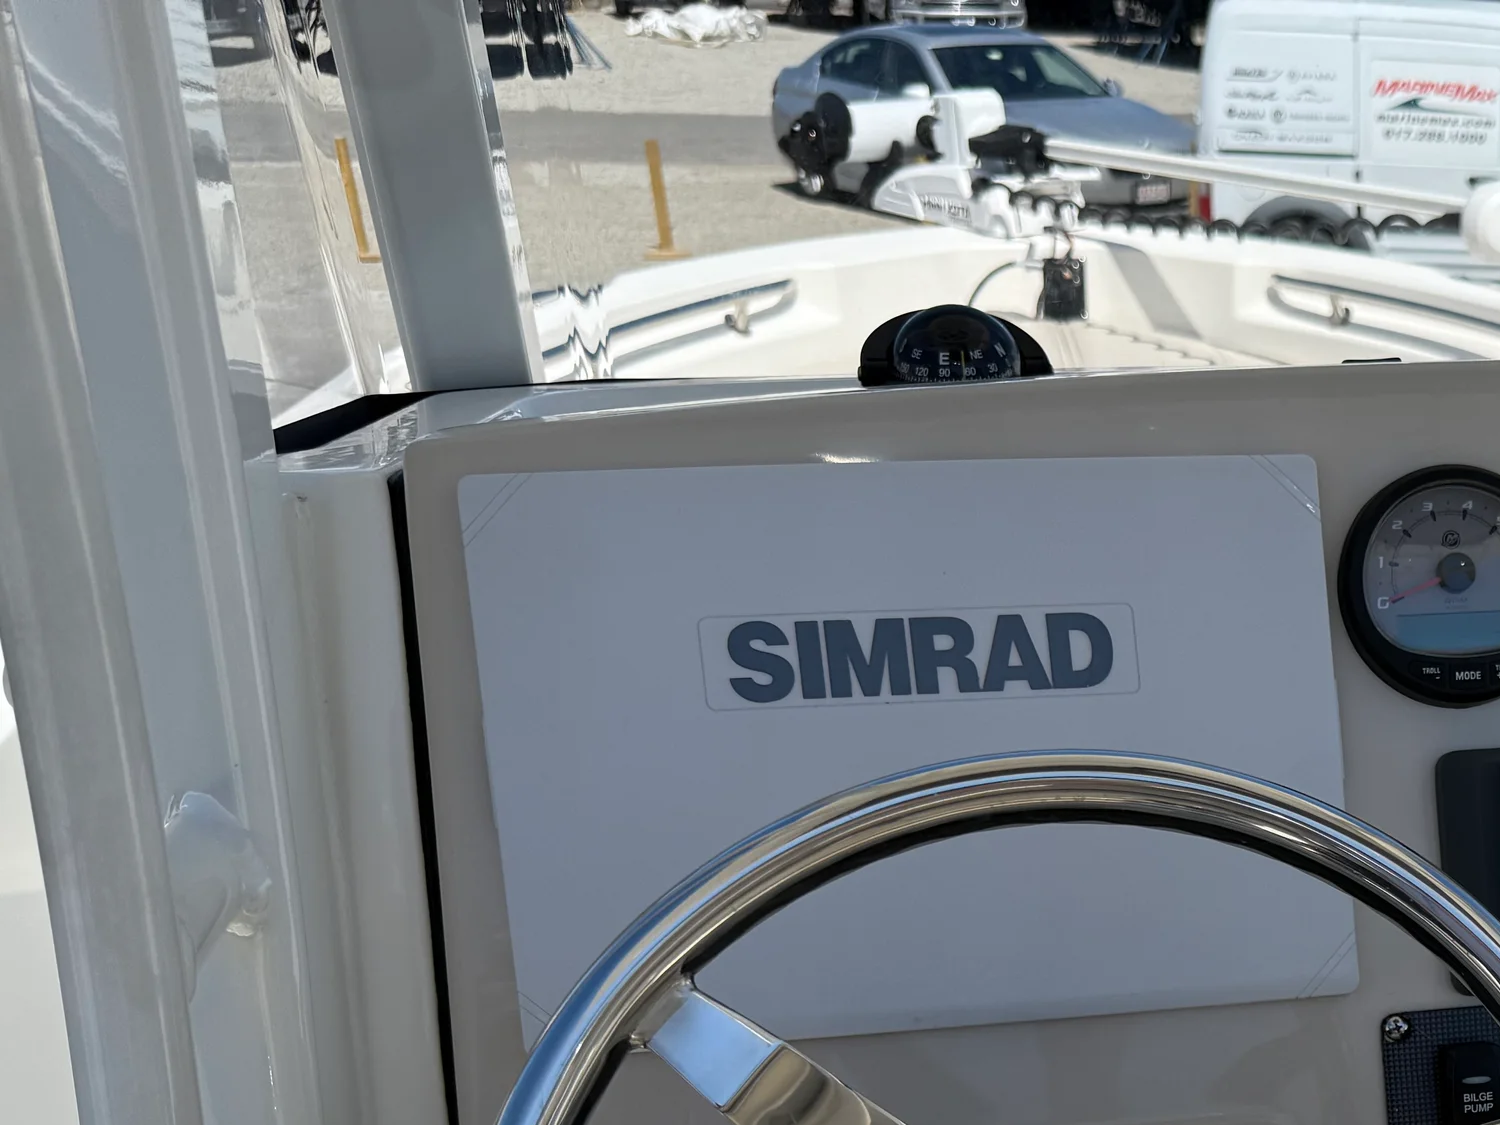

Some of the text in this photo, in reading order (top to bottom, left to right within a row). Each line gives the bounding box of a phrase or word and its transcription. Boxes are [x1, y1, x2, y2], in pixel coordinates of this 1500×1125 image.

[911, 342, 1007, 366] SE E NE N
[915, 367, 929, 377] 120
[939, 368, 950, 378] 90
[1421, 502, 1433, 512] 3
[1462, 500, 1474, 510] 4
[1392, 520, 1403, 530] 2
[1378, 556, 1384, 569] 1
[1377, 596, 1390, 609] 0
[727, 611, 1114, 703] SIMRAD
[1422, 667, 1440, 675] TROLL
[1455, 671, 1482, 681] MODE
[1463, 1091, 1494, 1103] BILGE
[1464, 1103, 1494, 1114] PUMP
